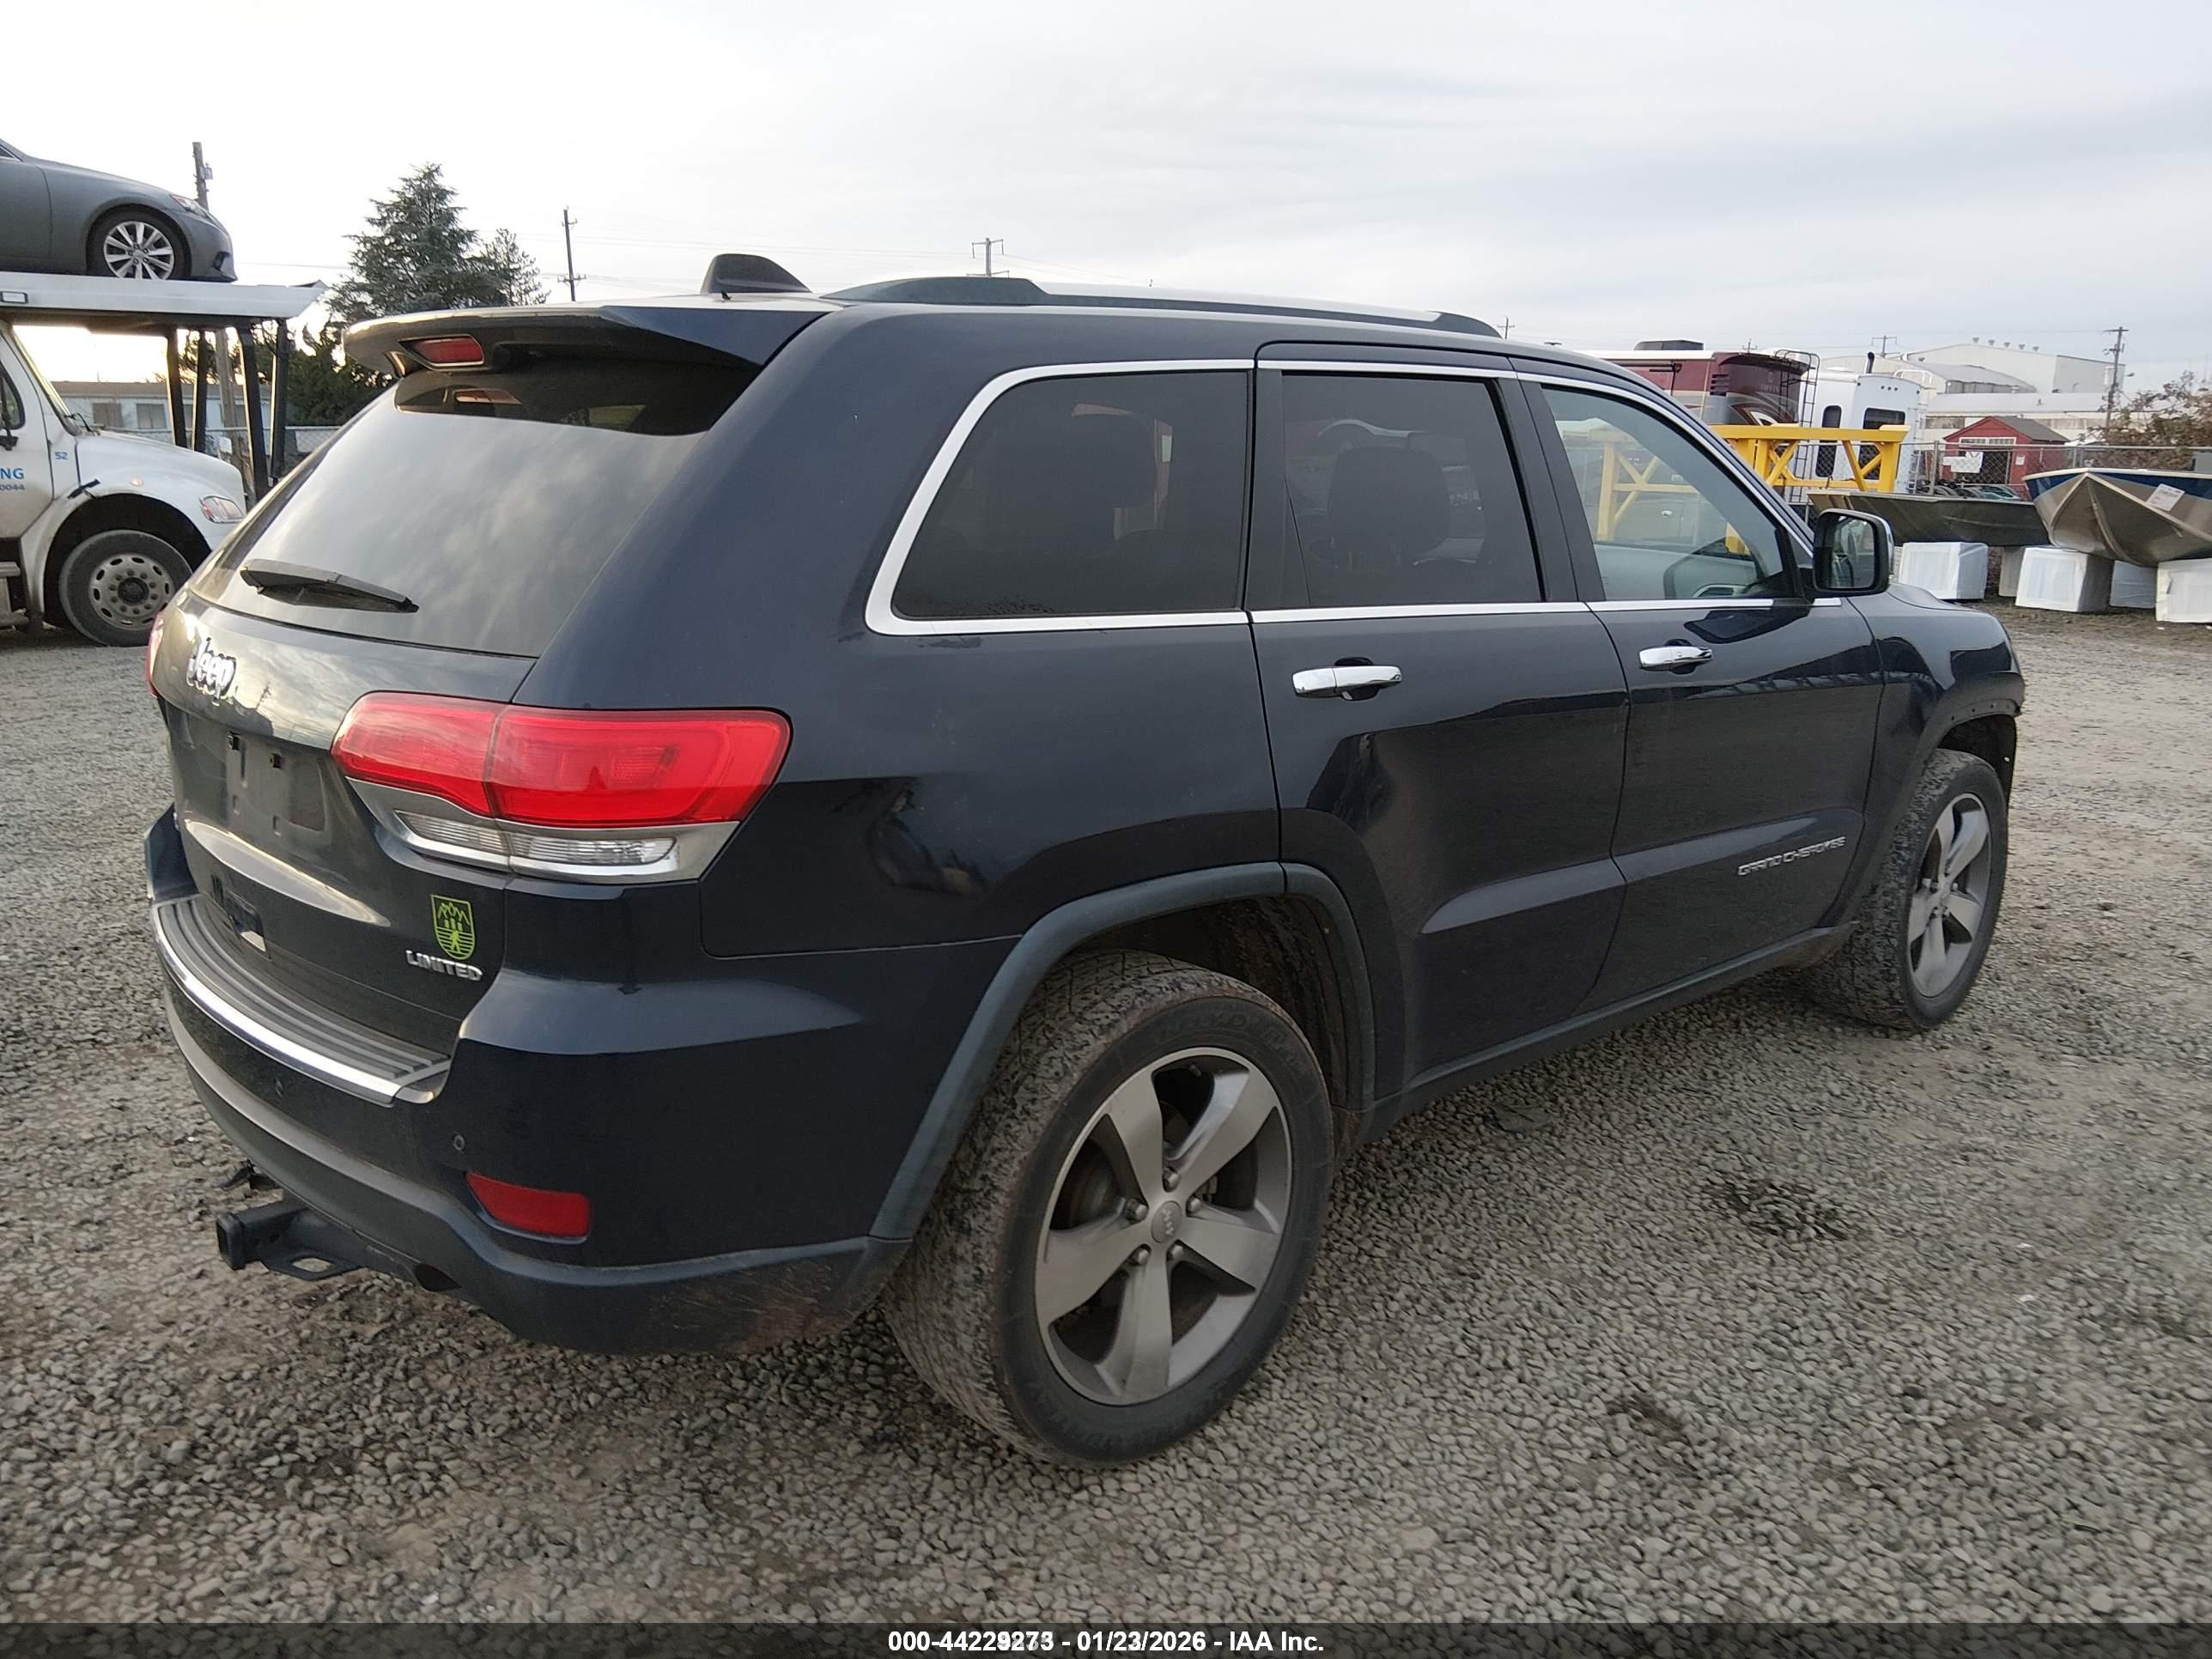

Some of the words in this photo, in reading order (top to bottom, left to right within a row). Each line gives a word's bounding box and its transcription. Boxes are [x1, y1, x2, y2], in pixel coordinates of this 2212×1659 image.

[0, 467, 24, 479] NG
[186, 636, 237, 700] Jeep
[1737, 854, 1783, 876] GRAND
[405, 950, 483, 981] LIMITED
